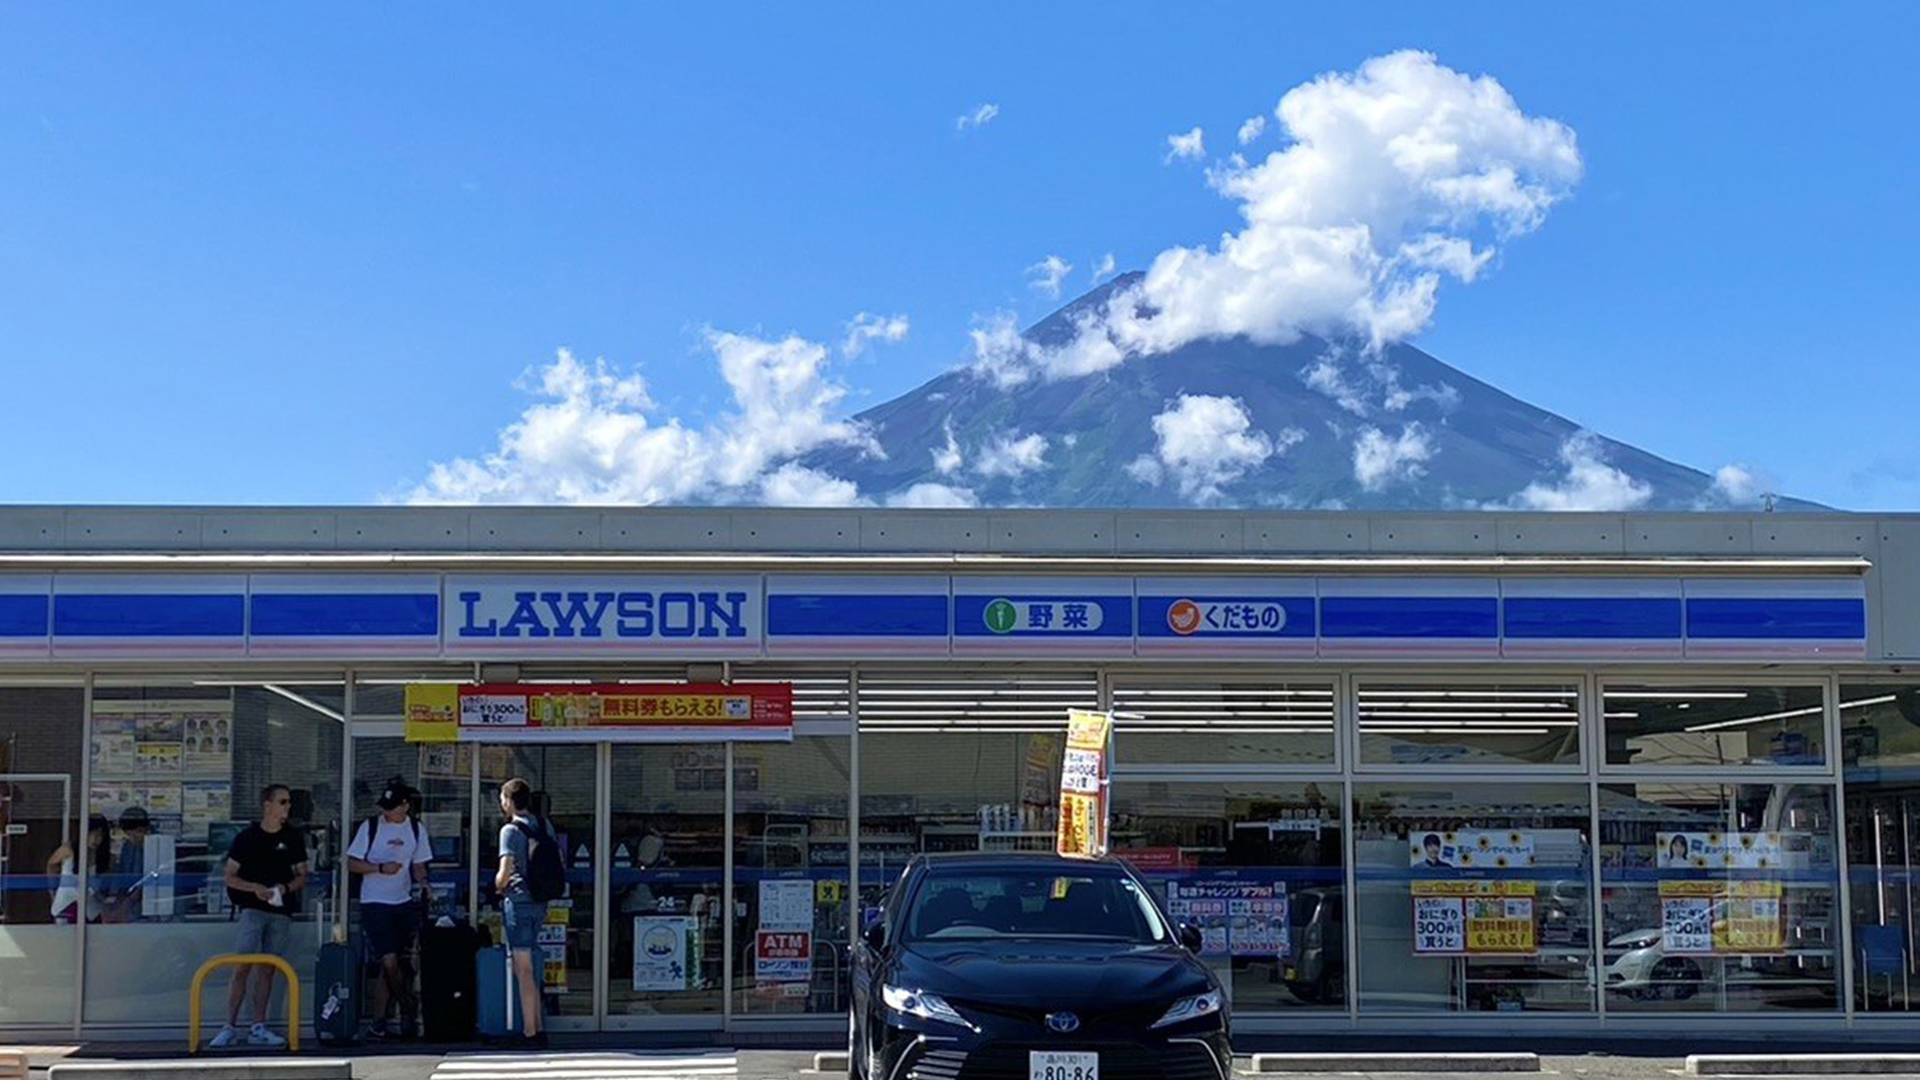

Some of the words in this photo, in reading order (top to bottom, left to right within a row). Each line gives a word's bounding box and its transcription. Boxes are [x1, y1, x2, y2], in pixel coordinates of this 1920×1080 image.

[459, 592, 747, 637] LAWSON
[1029, 603, 1088, 629] 野菜
[1206, 603, 1280, 629] くだもの
[1419, 908, 1458, 920] おにぎり
[764, 935, 803, 949] ATM
[1425, 936, 1455, 948] 買うと
